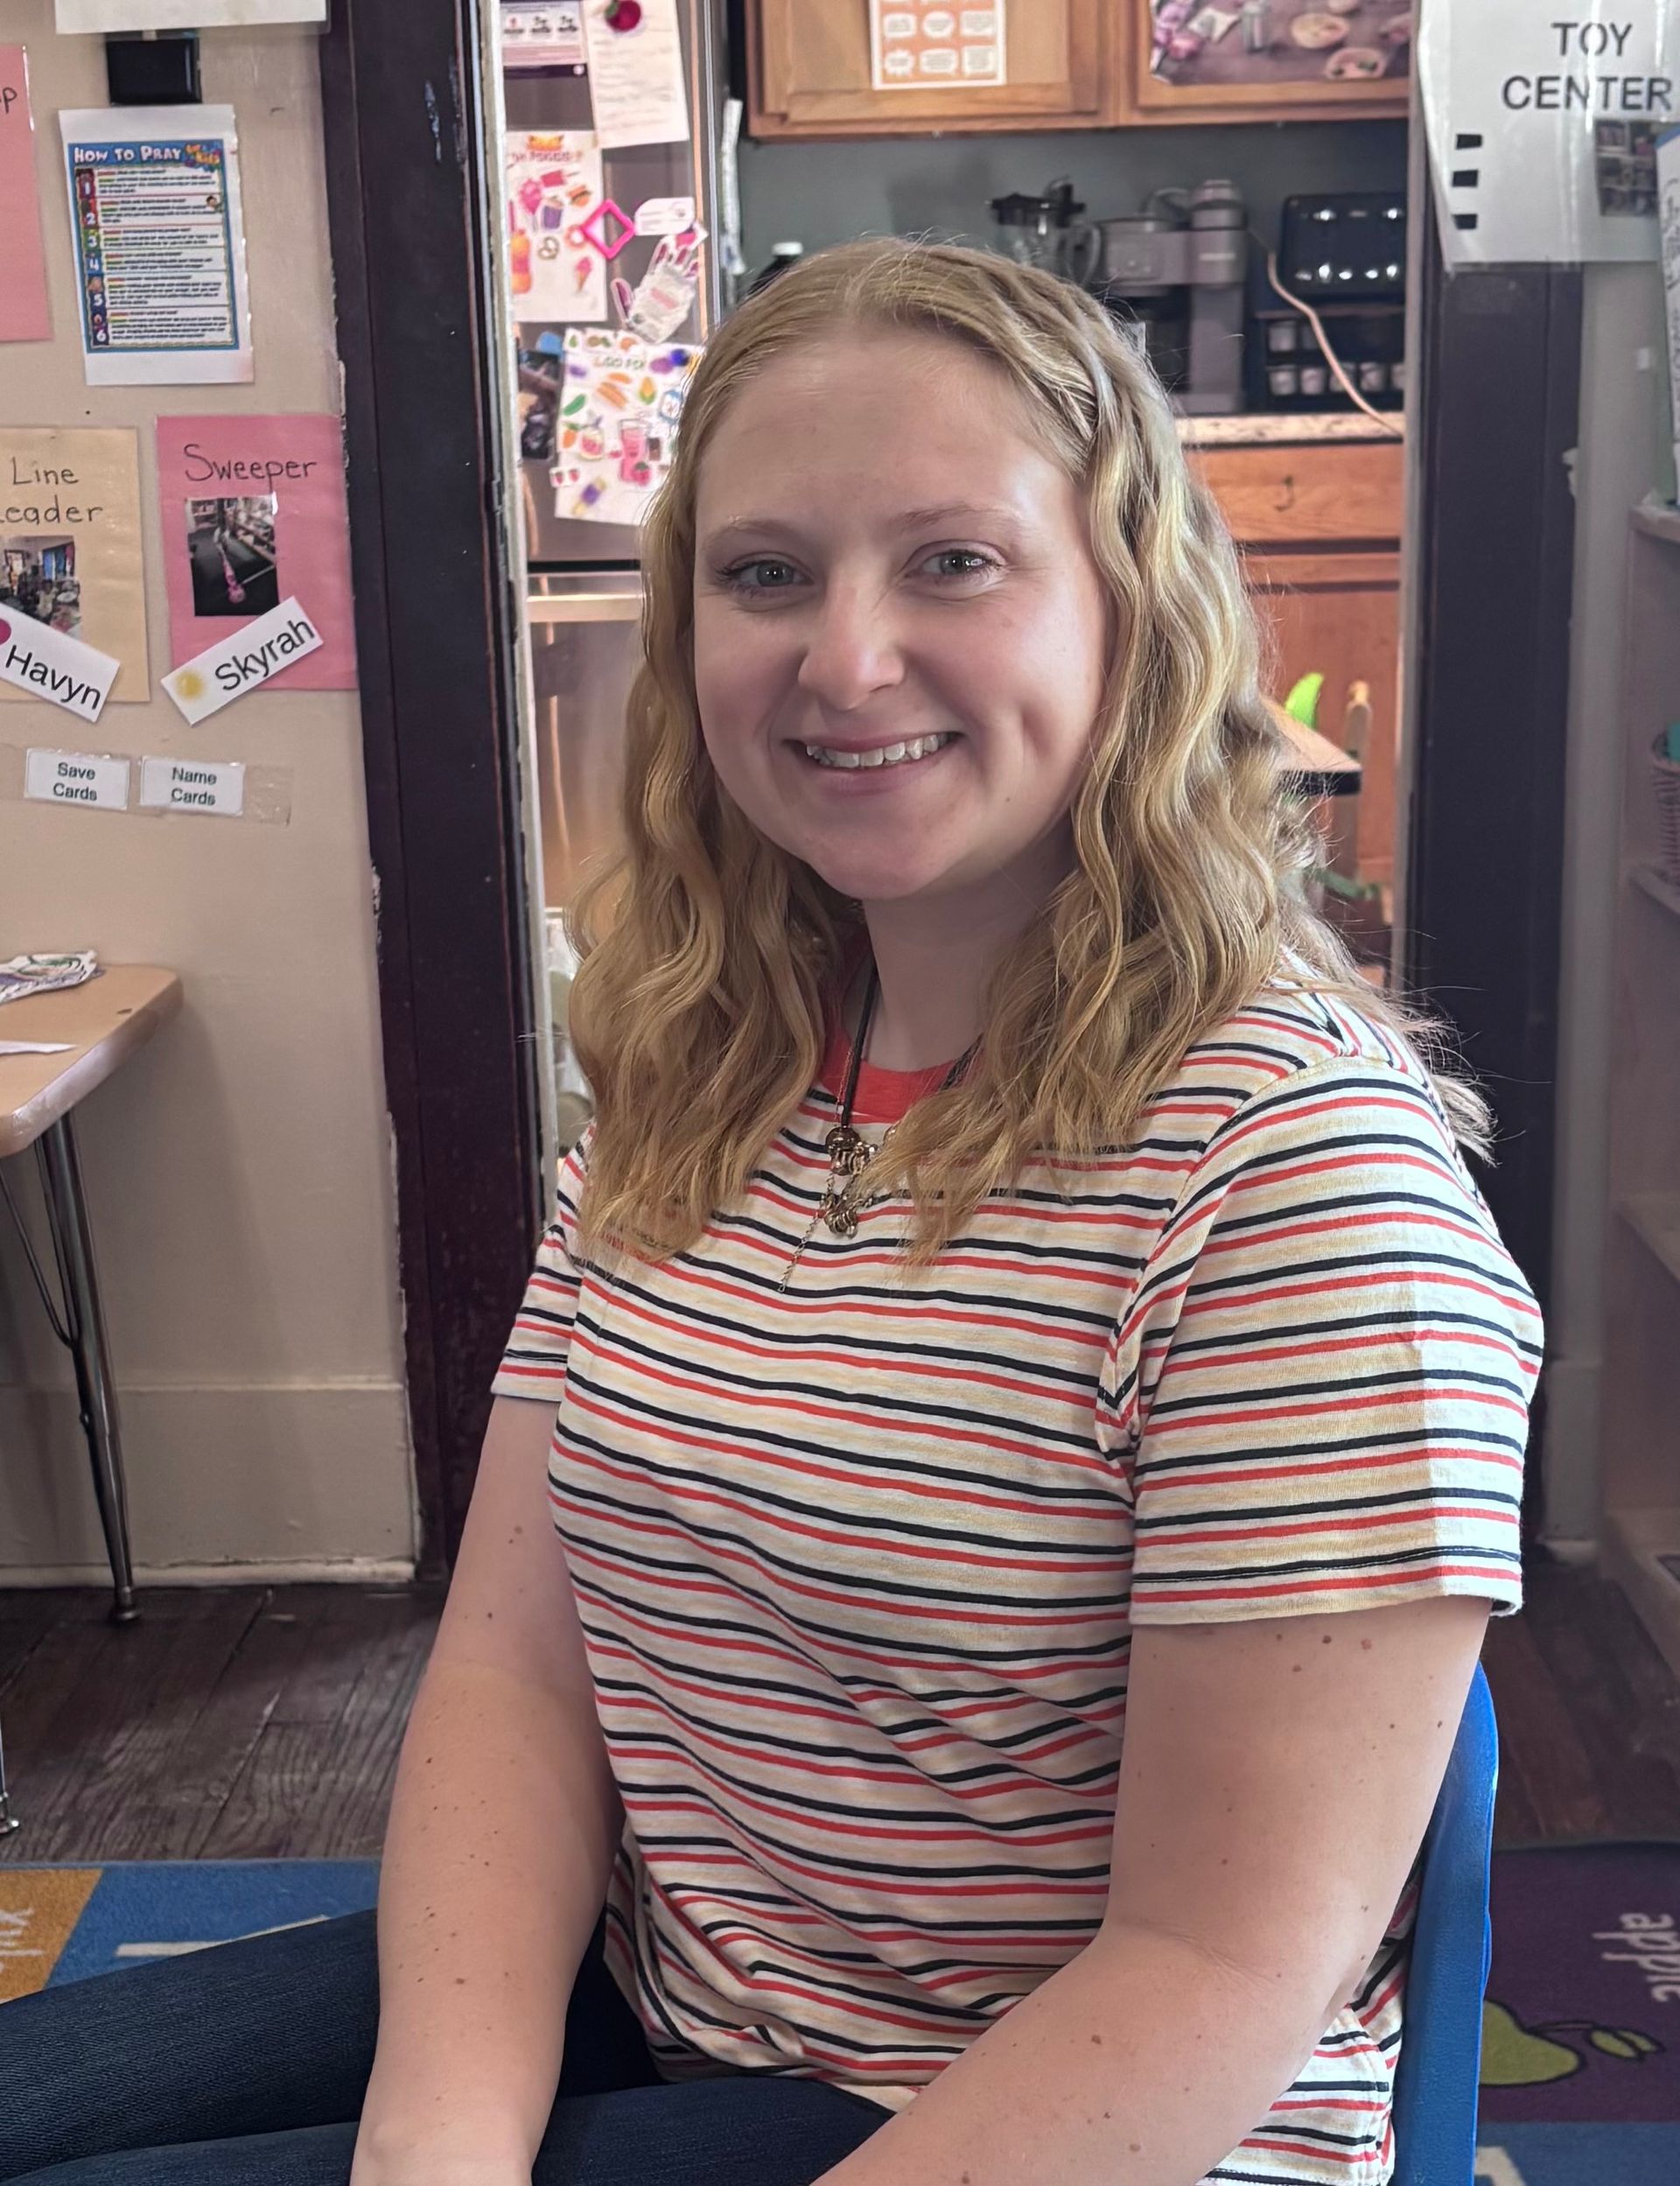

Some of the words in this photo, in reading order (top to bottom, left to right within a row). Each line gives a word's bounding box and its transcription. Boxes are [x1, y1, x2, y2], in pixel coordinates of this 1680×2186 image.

[1550, 22, 1633, 57] TOY
[1502, 75, 1672, 111] CENTER
[11, 457, 80, 486] Line
[184, 443, 318, 493] Sweeper
[0, 494, 103, 526] eader
[214, 619, 316, 691] Skyrah
[5, 643, 102, 711] Havyn
[57, 761, 95, 781] Save
[172, 767, 217, 786] Name
[52, 782, 98, 802] Cards
[171, 788, 216, 807] Cards
